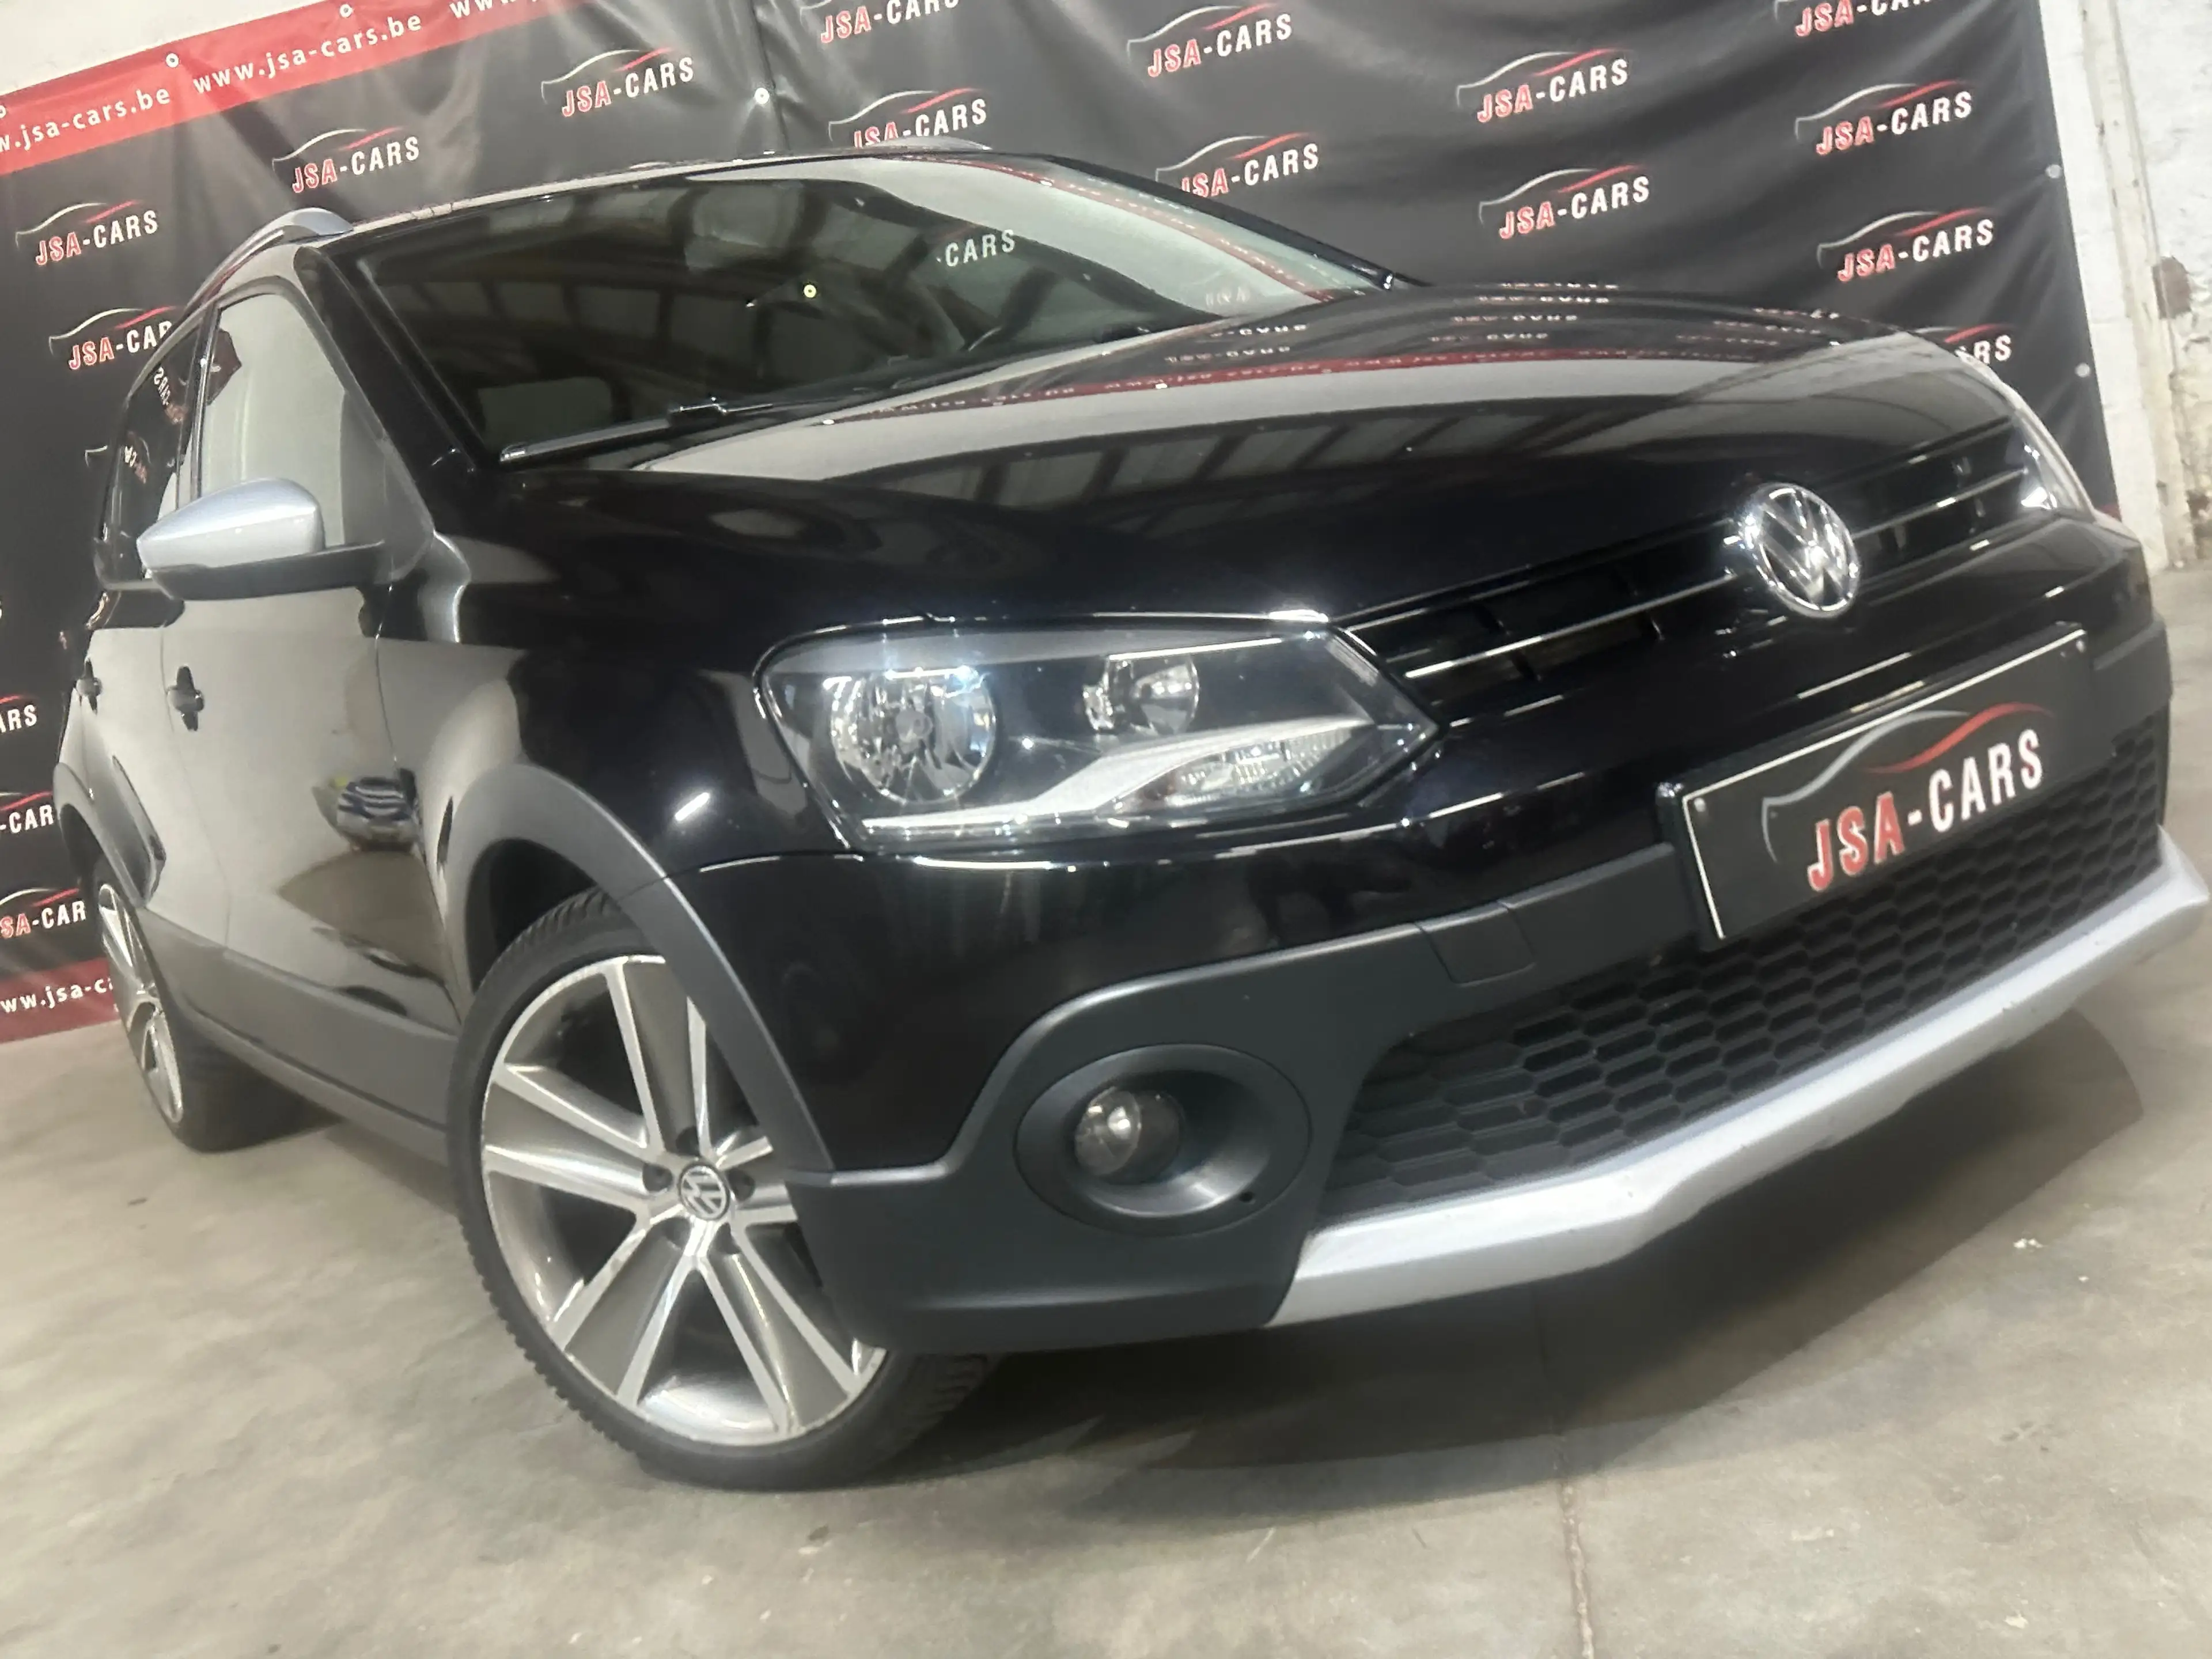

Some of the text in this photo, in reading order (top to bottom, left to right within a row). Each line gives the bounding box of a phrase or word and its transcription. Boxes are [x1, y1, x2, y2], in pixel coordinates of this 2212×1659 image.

[194, 13, 422, 93] www.jsa-cars.be
[1147, 14, 1292, 77] JSA-CARS
[562, 57, 694, 117] JSA-CARS
[1477, 58, 1628, 123] JSA-CARS
[1816, 90, 1972, 156] JSA-CARS
[292, 137, 421, 194] JSA-CARS
[35, 210, 158, 266] JSA-CARS
[1499, 176, 1650, 240] JSA-CARS
[1837, 219, 1995, 283] JSA-CARS
[1806, 728, 2043, 892] JSA-CARS
[0, 900, 86, 940] SA-CAR
